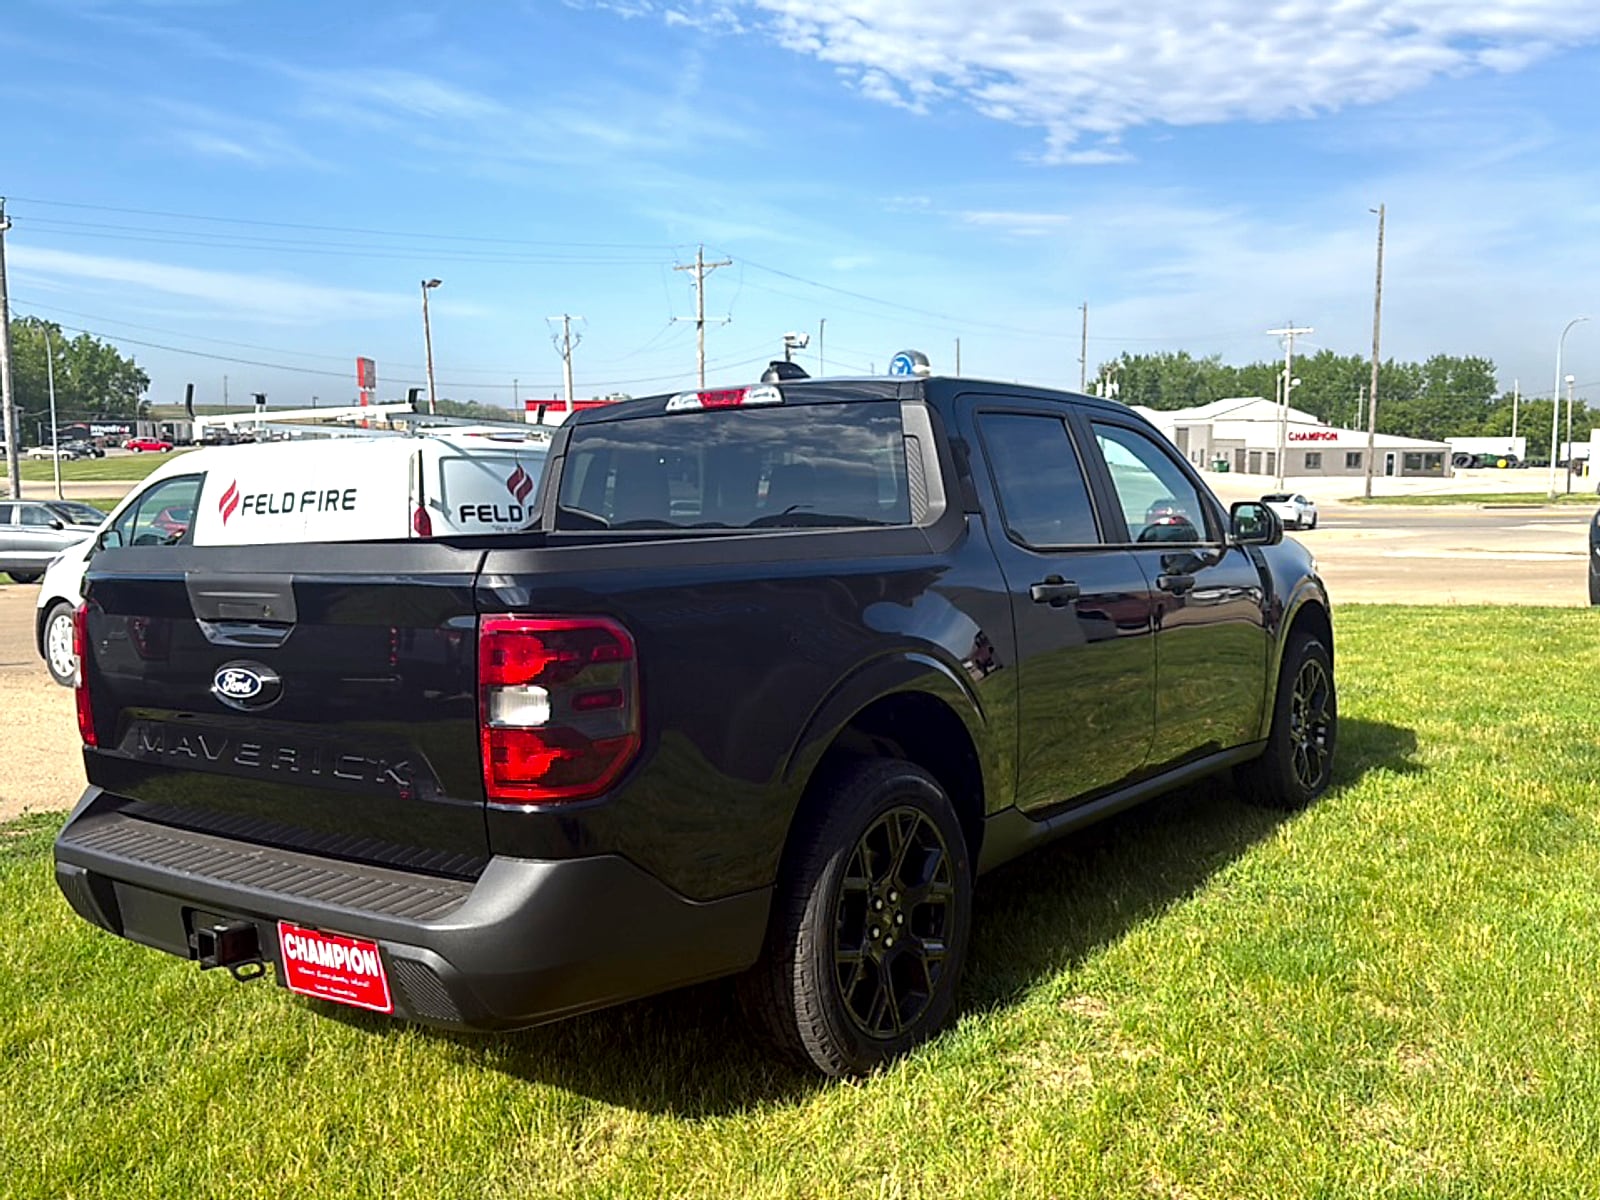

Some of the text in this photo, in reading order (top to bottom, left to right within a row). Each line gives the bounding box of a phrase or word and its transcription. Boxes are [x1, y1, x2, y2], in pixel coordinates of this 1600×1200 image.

[1288, 431, 1338, 441] CHAMPION
[241, 488, 357, 516] FELD FIRE
[459, 504, 523, 523] FELD
[222, 672, 252, 693] Ford
[137, 728, 413, 786] MAVERICK
[284, 932, 379, 977] CHAMPION
